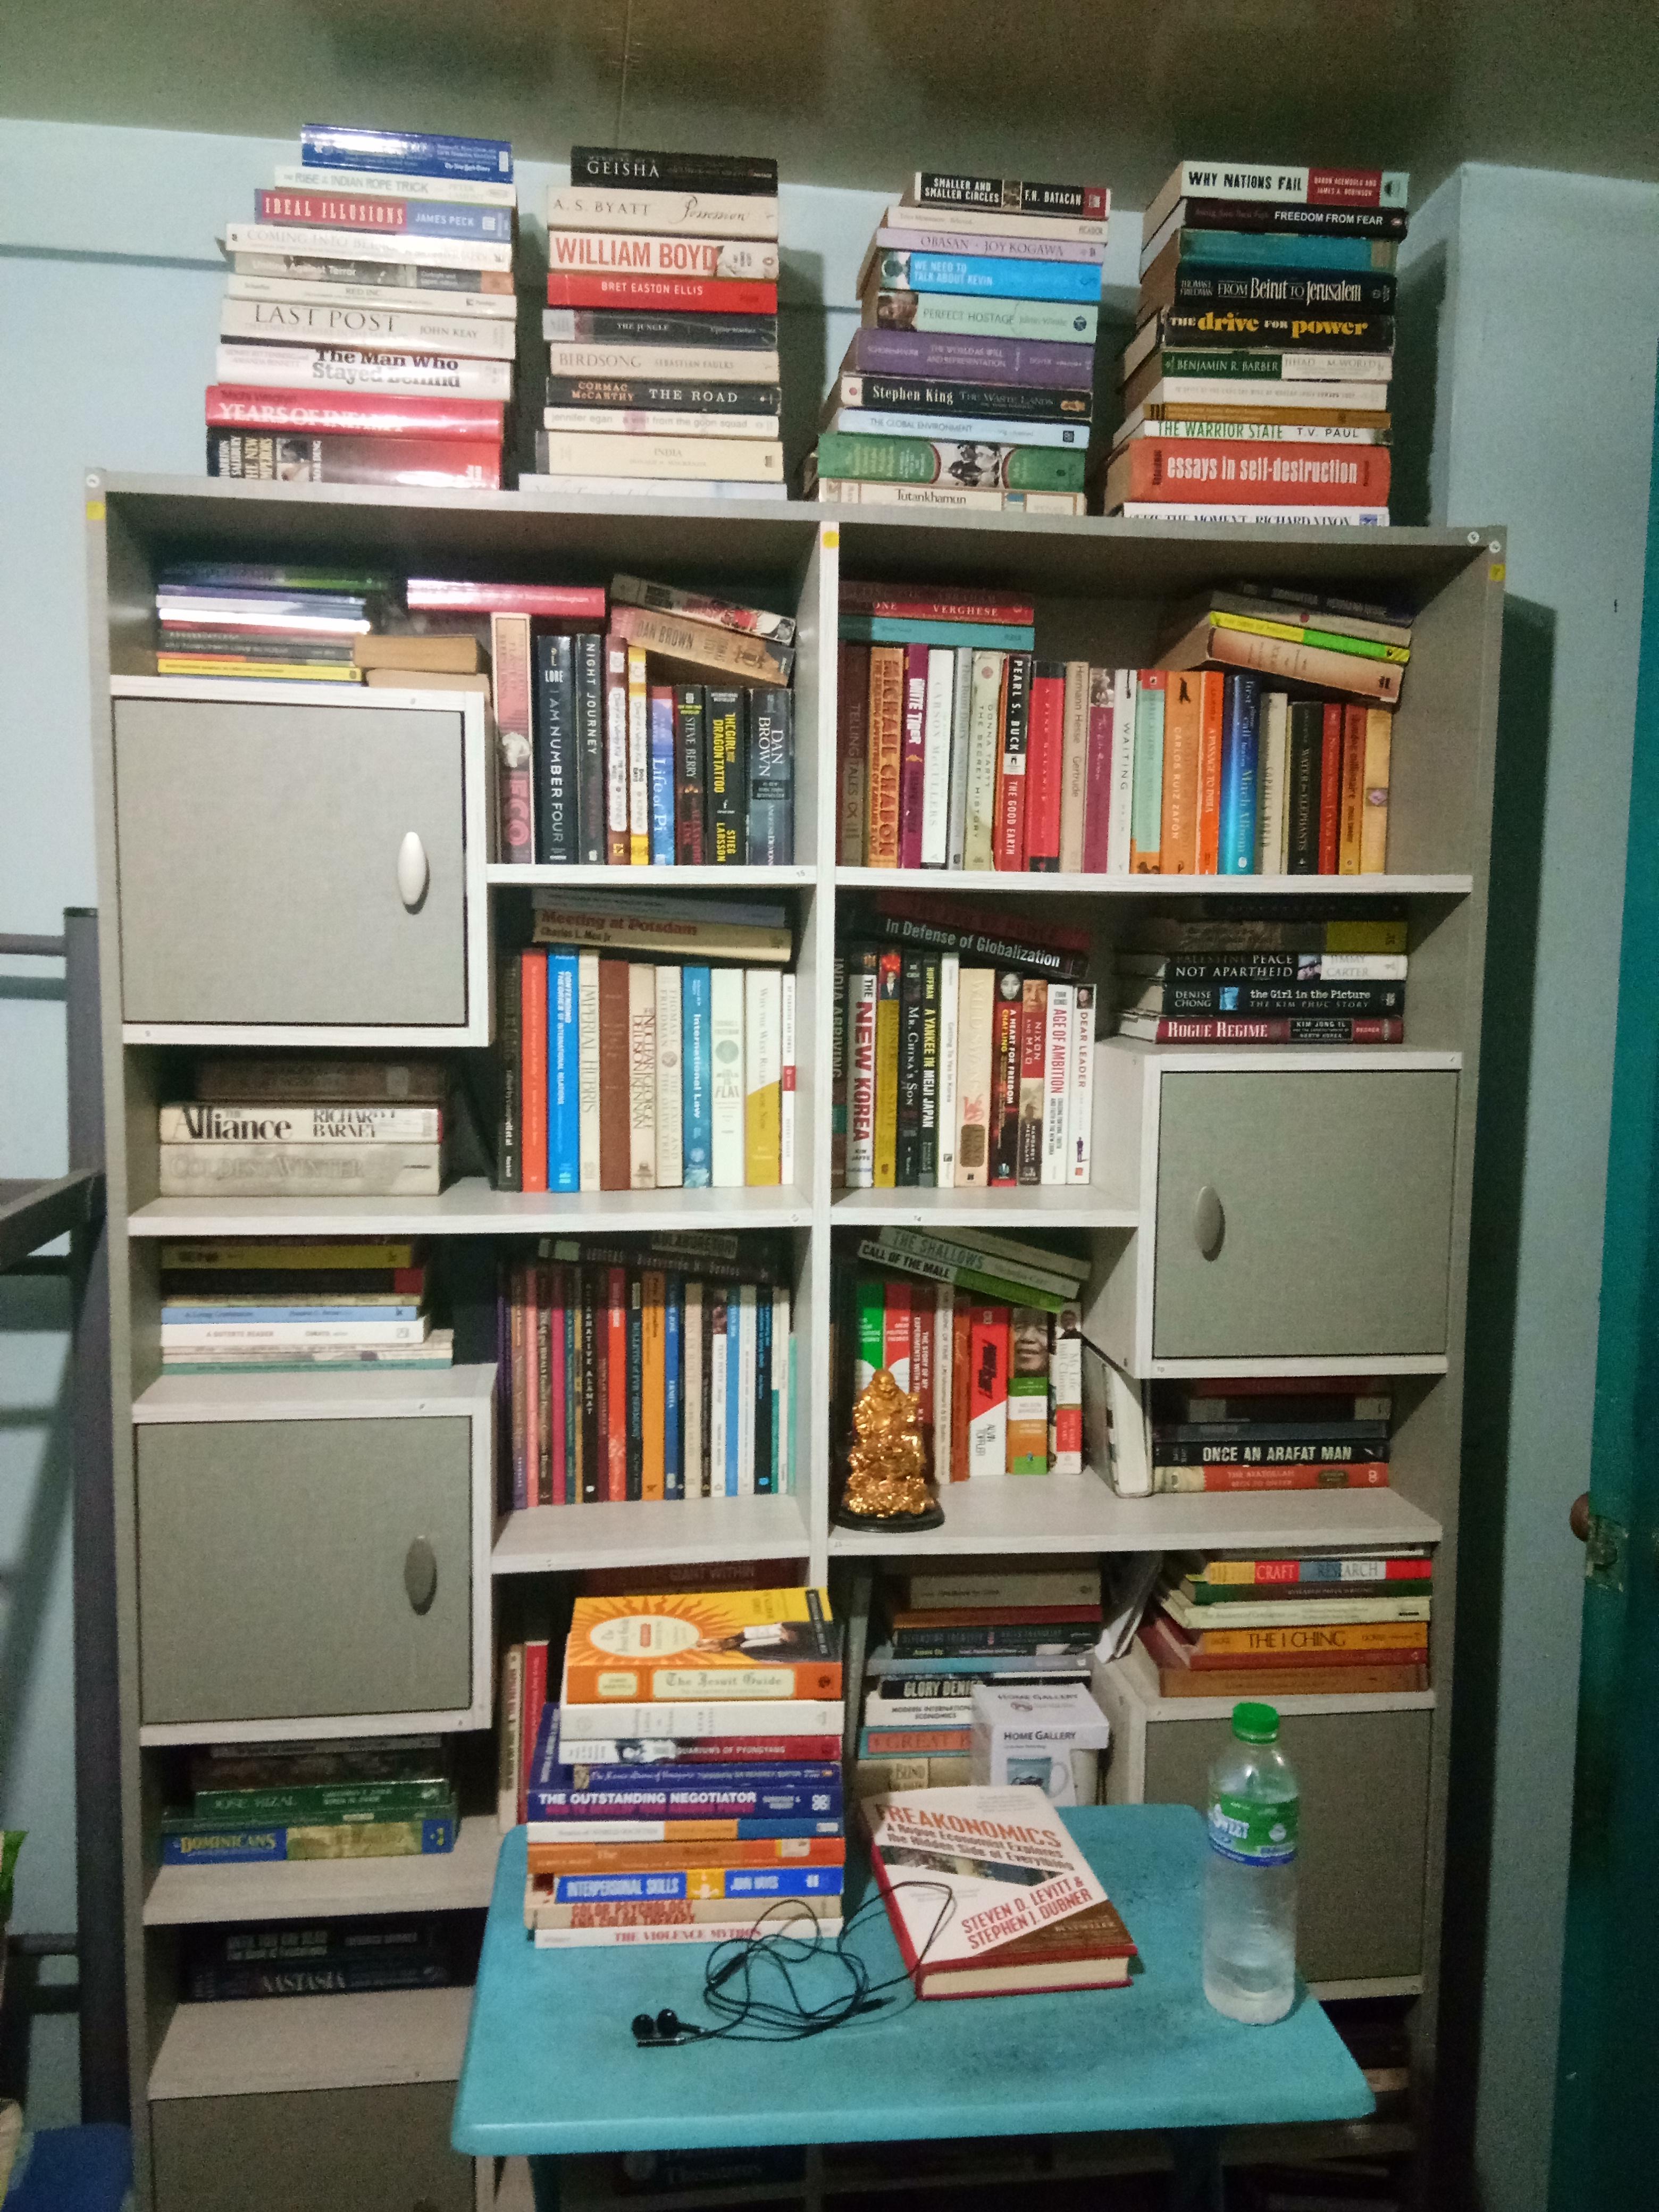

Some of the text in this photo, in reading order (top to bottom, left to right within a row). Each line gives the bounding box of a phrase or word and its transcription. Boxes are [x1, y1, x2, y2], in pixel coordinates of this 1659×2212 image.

[587, 161, 659, 179] GEISHA
[331, 175, 429, 193] INDIAN ROPE TRICK
[934, 178, 992, 190] SMALLER AND
[1188, 171, 1302, 191] WHY NATIONS FAIL
[925, 188, 1000, 203] SMALLER CIRCLES
[265, 198, 404, 225] IDEAL ILLUSIONS
[595, 202, 651, 216] BYATT
[1275, 211, 1382, 225] FREEDOM FROM FEAR
[415, 213, 474, 227] JAMES PECK
[920, 237, 969, 250] OBASAN
[984, 240, 1064, 256] JOY KOGAWA
[555, 237, 718, 271] WILLIAM BOYD
[601, 281, 703, 296] BRET EASTON ELLIS
[1218, 277, 1362, 305] FROM Beirut TO Jerusalem
[255, 304, 400, 333] LAST POST
[1170, 312, 1369, 339] THE drive FOR power
[420, 325, 477, 339] JOHN KEAY
[316, 349, 458, 371] The Man Who
[559, 353, 642, 368] BIRDSONG
[1177, 358, 1278, 372] BENJAMIN BARBER
[577, 382, 628, 392] CORMAC
[649, 388, 739, 403] THE ROAD
[873, 385, 954, 405] Stephen King
[1158, 421, 1283, 440] THE WARRIOR STATE
[1297, 426, 1359, 438] T.V. PAUL
[1167, 456, 1358, 484] essays in self-destruction
[933, 603, 999, 617] VERGHESE
[658, 625, 694, 651] BROWN
[544, 670, 564, 683] LORE
[586, 643, 598, 755] NIGHT JOURNEY
[1010, 659, 1024, 757] PEARL S. BUCK
[685, 717, 697, 780] STEVE BERRY
[713, 719, 724, 793] DRAGON TATTOO
[758, 717, 771, 778] BROWN
[771, 729, 784, 765] DAN
[1120, 723, 1131, 791] WAITING
[549, 700, 564, 843] AM NUMBER FOUR
[1172, 726, 1182, 800] CARLOS RUIZ
[653, 757, 667, 832] Life of Pi
[1006, 781, 1018, 855] THE GOOD EARTH
[886, 919, 1062, 968] In Defense of Globalization
[1252, 955, 1293, 965] PEACE
[1176, 966, 1294, 978] NOT APARTHEID
[1175, 991, 1212, 999] DENISE
[1175, 999, 1212, 1008] CHONG
[1250, 989, 1371, 1000] the Girl in the Picture
[1167, 1021, 1268, 1038] ROGUE REGIME
[1034, 1021, 1042, 1061] NIXON
[1050, 1008, 1067, 1094] AGE OF AMBITION
[1077, 1012, 1088, 1088] DEAR LEADER
[692, 1014, 702, 1118] International Law
[852, 978, 874, 1142] THE NEW KOREA
[921, 1019, 935, 1128] YANKEE MEIJI JAPAN
[1007, 1065, 1016, 1105] FREEDOM
[891, 1231, 986, 1270] THE SHALLOWS
[862, 1244, 951, 1278] CALL OF THE MALL
[1202, 1446, 1352, 1462] ONCE AN ARAFAT MAN
[1256, 1564, 1295, 1580] CRAFT
[1248, 1631, 1346, 1649] THE CHING
[903, 1681, 941, 1698] GLORY
[1003, 1731, 1077, 1741] HOME GALLERY
[540, 1791, 757, 1805] THE OUTSTANDING NEGOTIATOR
[875, 1804, 1062, 1848] FREAKONOMICS
[615, 1901, 692, 1915] PSYCHOLOGY
[960, 1879, 1071, 1934] STEVEN D. LEVITT
[966, 1889, 1093, 1950] STEPHEN DUBNER
[615, 1930, 707, 1942] THE VIOLENCE
